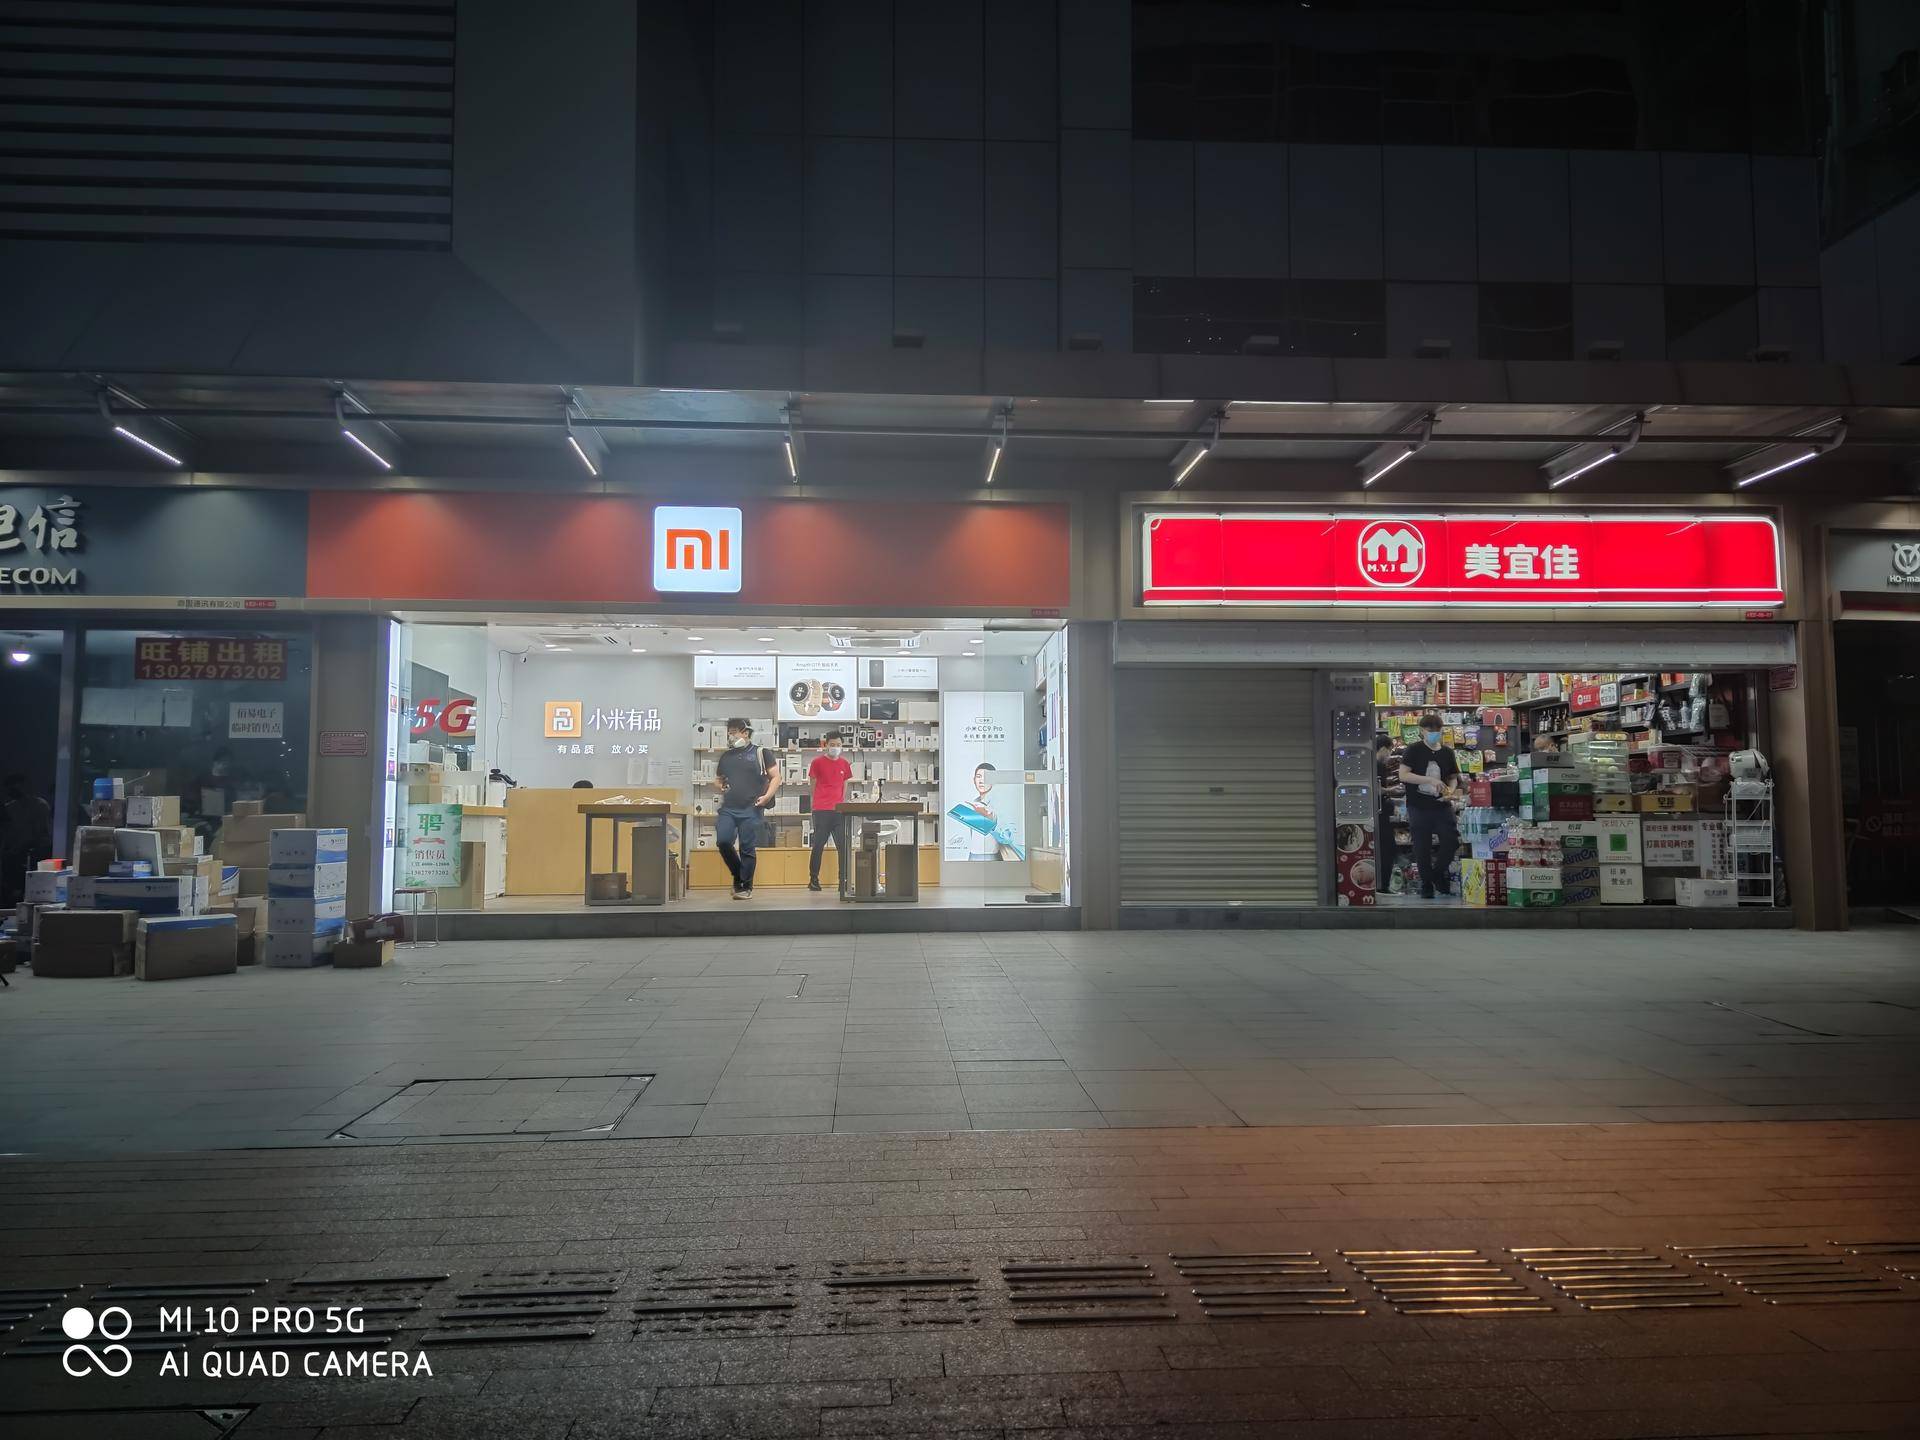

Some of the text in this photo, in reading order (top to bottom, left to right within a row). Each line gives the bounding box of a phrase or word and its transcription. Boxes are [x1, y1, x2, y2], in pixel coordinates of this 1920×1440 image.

[1464, 543, 1580, 580] 美宜佳
[141, 641, 285, 663] 旺铺出租
[142, 664, 281, 680] 13027973202
[409, 699, 474, 734] 5G
[587, 708, 661, 731] 小米有品
[557, 744, 649, 755] 有品质 放心买
[417, 814, 445, 836] 聘
[415, 849, 446, 860] 销售员
